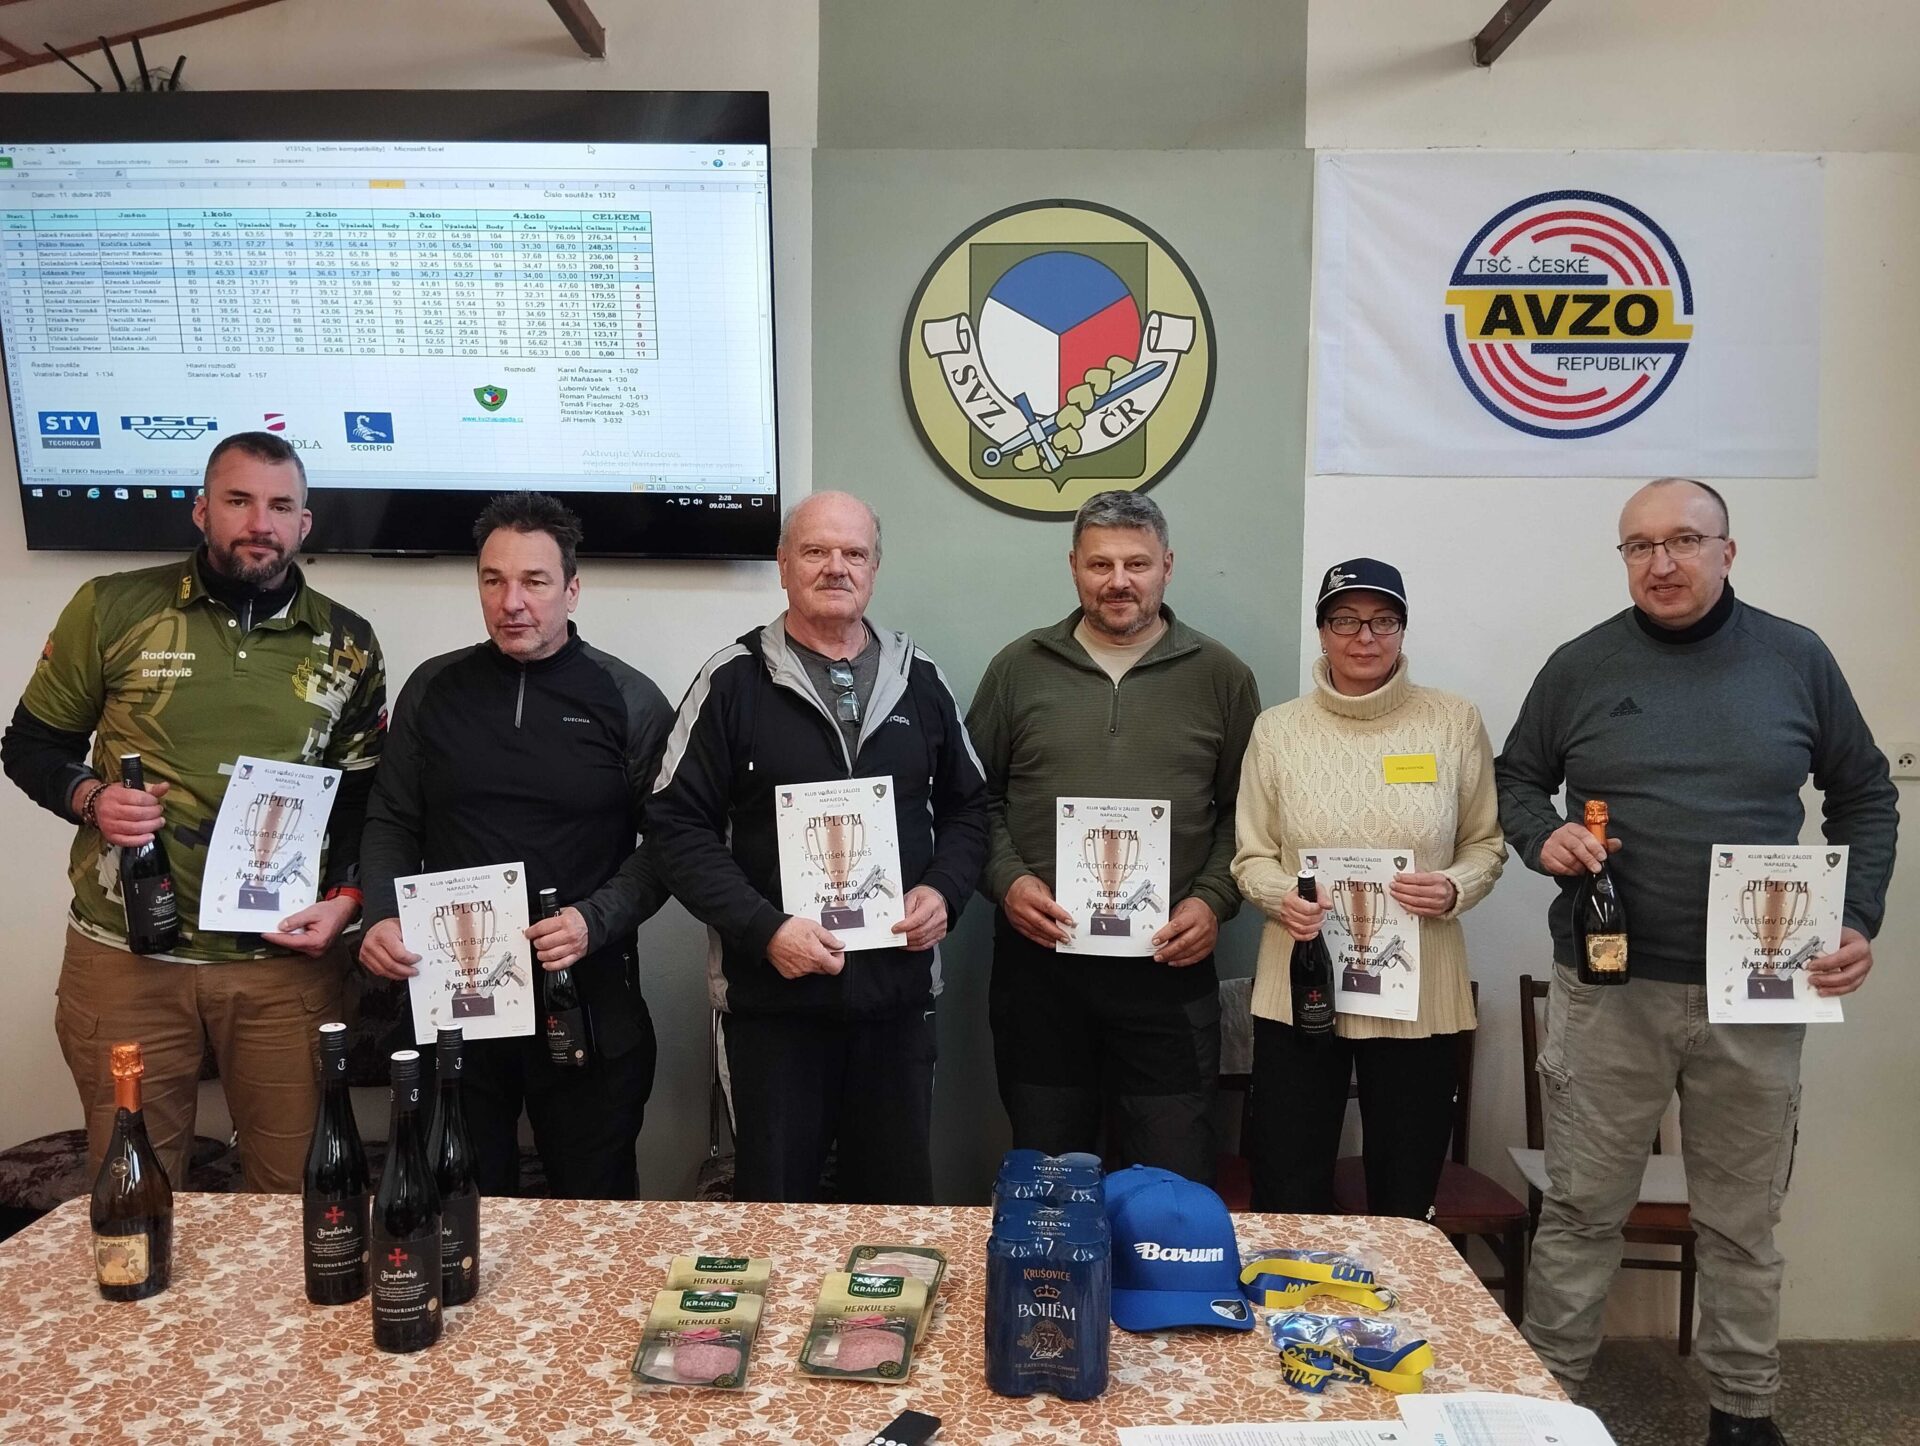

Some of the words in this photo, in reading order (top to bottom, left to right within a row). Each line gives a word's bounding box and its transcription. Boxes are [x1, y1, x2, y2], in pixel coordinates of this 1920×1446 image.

[1476, 256, 1512, 274] TSČ
[1528, 255, 1590, 274] ČESKÉ
[1479, 293, 1660, 337] AVZO
[1557, 356, 1662, 372] REPUBLIKY
[951, 364, 1007, 429] SVZ
[1099, 398, 1147, 438] ČR
[46, 416, 92, 431] STV
[632, 449, 681, 458] Windows
[141, 650, 196, 661] Radovan
[142, 666, 193, 678] Bartovič
[254, 793, 305, 810] DIPLOM
[808, 813, 862, 828] DIPLOM
[234, 826, 270, 838] Radovan
[272, 830, 305, 842] Bartovič
[1087, 828, 1138, 840] DIPLOM
[804, 850, 845, 861] František
[248, 860, 279, 870] REPIKO
[1076, 860, 1110, 869] Antonín
[1112, 862, 1149, 872] Kopečný
[235, 872, 288, 883] NAPAJEDLA
[824, 880, 858, 890] REPIKO
[1334, 880, 1383, 894] DIPLOM
[1746, 880, 1808, 893] DIPLOM
[814, 892, 870, 904] NAPAJEDLA
[435, 900, 493, 918] DIPLOM
[1086, 902, 1138, 910] NAPAJEDLA
[1327, 913, 1350, 922] Lenka
[1352, 915, 1398, 926] Doležalová
[1733, 916, 1776, 926] Vratislav
[1780, 917, 1818, 926] Doležal
[428, 938, 467, 951] Lubomír
[470, 934, 509, 946] Bartovič
[1348, 944, 1379, 953] REPIKO
[1754, 948, 1791, 956] REPIKO
[1338, 955, 1389, 967] NAPAJEDLA
[1742, 962, 1802, 970] NAPAJEDLA
[455, 966, 489, 977] REPIKO
[444, 979, 501, 991] NAPAJEDLA
[1134, 1242, 1224, 1263] Barum
[1023, 1267, 1071, 1282] KRUŠOVICE
[693, 1277, 744, 1286] HERKULES
[852, 1283, 897, 1294] KRAHULÍK
[685, 1298, 731, 1309] KRAHULÍK
[844, 1304, 896, 1313] HERKULES
[1017, 1301, 1076, 1321] BOHÉM
[677, 1316, 731, 1327] HERKULES
